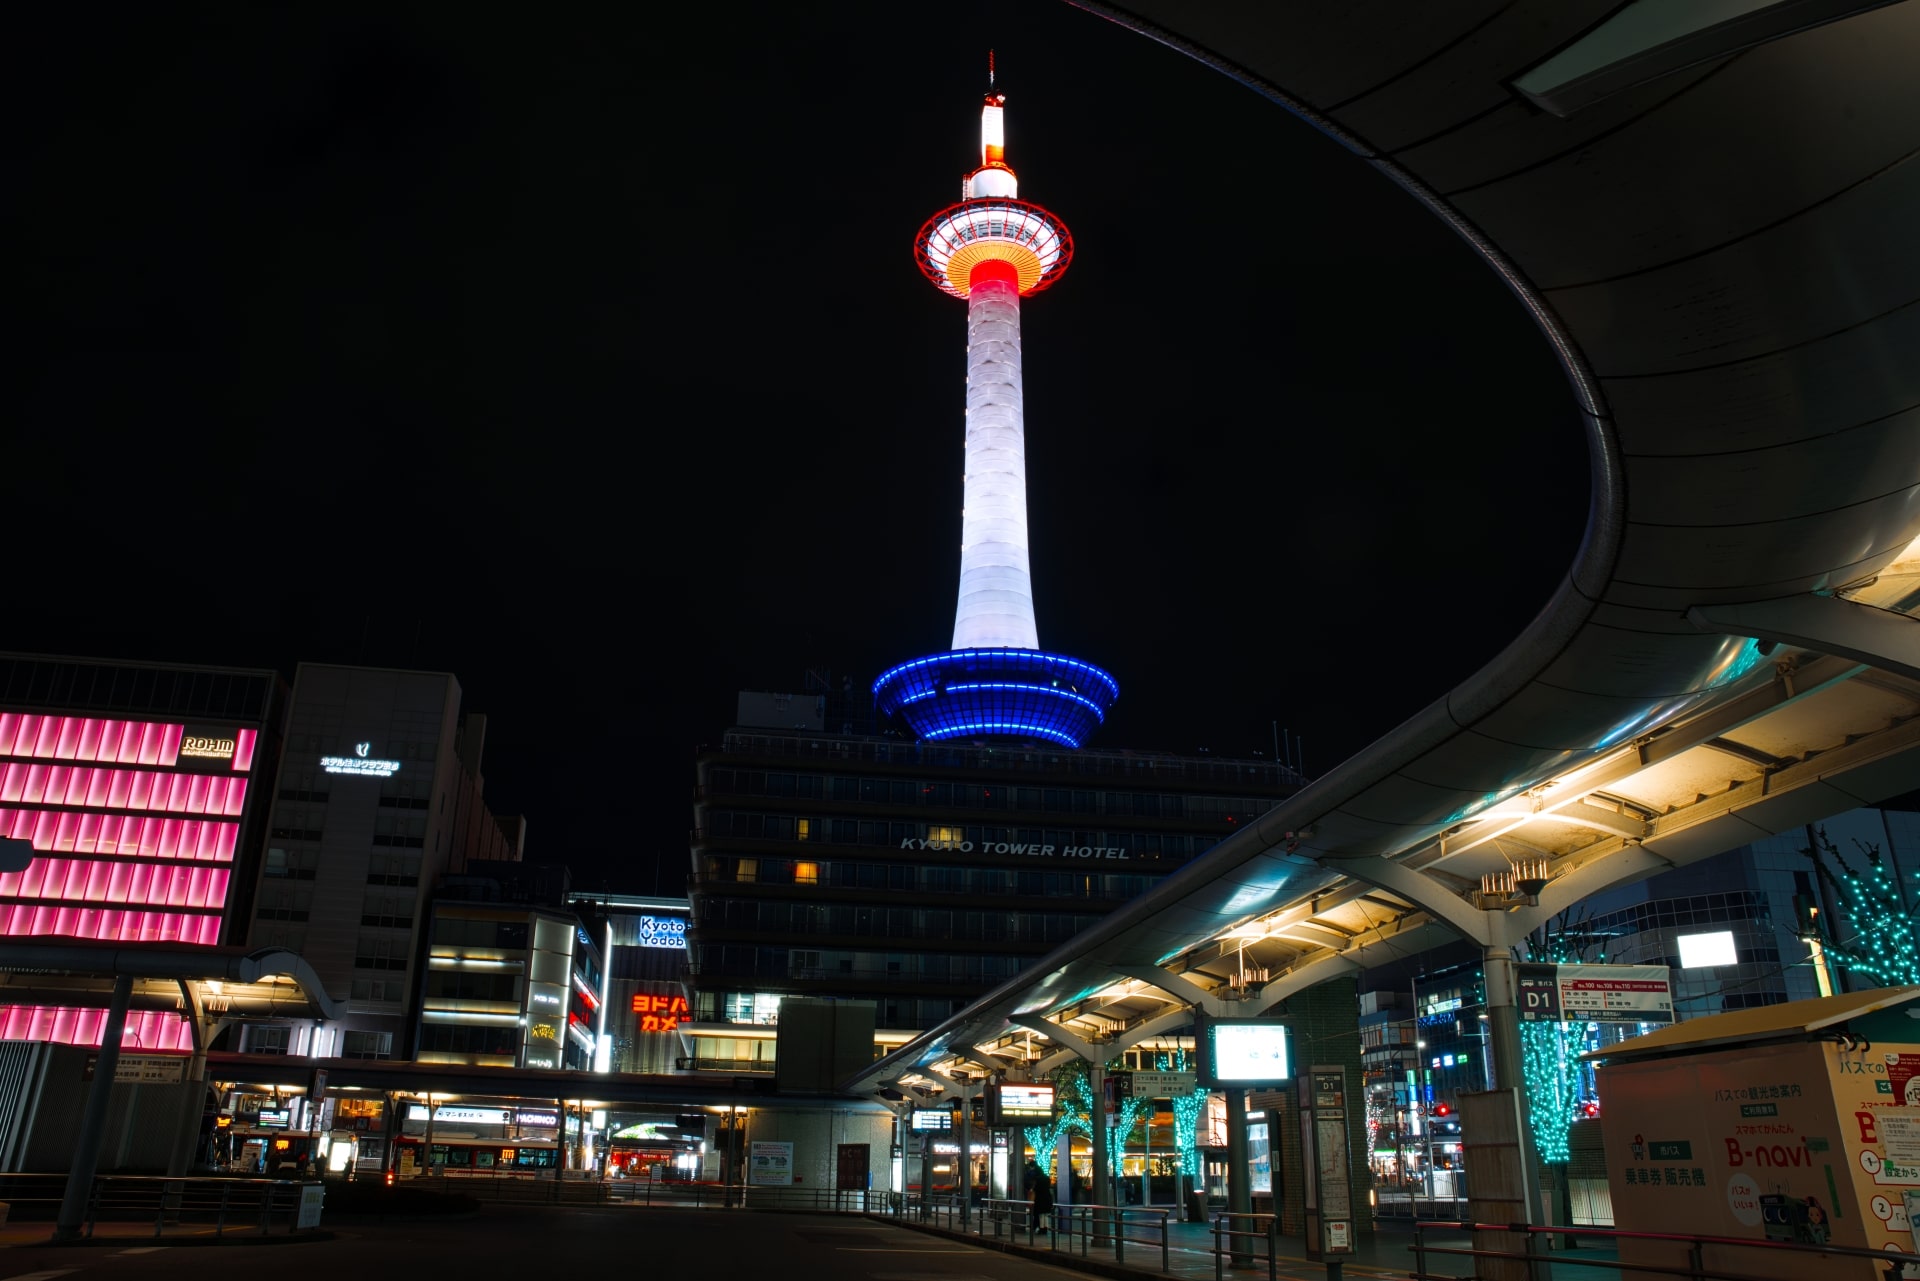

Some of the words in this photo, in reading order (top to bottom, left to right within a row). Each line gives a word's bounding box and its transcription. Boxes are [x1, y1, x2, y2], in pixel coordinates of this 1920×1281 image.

[183, 737, 234, 752] ROHM
[901, 838, 974, 853] KYOTO
[982, 842, 1056, 856] TOWER
[1063, 846, 1129, 859] HOTEL
[641, 918, 684, 931] Kyoto
[1527, 992, 1550, 1007] D1
[1660, 1146, 1680, 1155] 市バス
[1725, 1136, 1811, 1167] B-navi
[1878, 1203, 1885, 1212] 2
